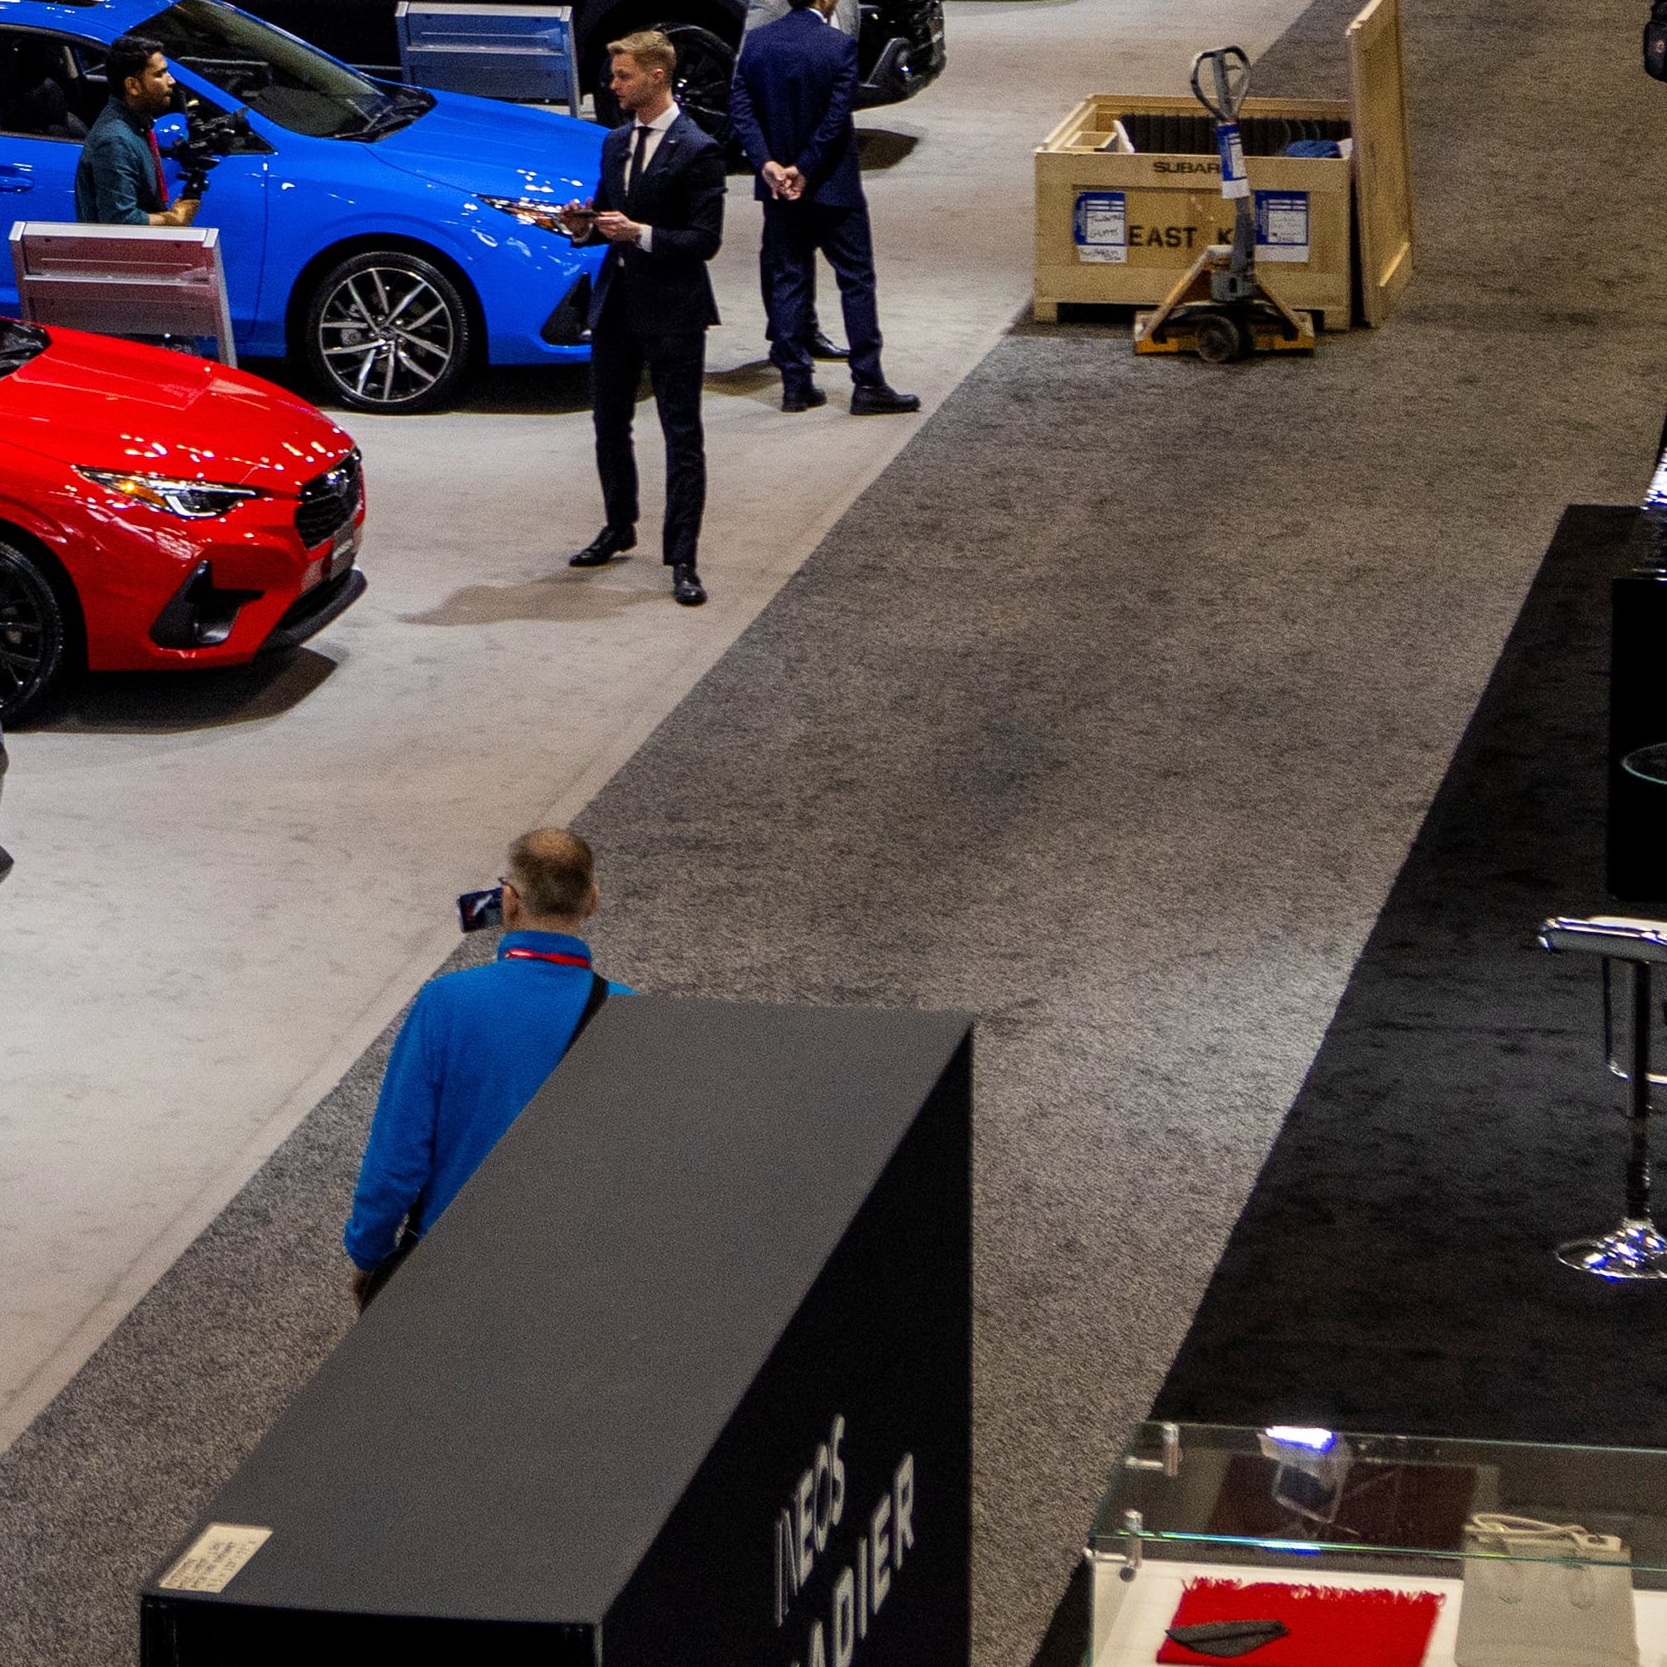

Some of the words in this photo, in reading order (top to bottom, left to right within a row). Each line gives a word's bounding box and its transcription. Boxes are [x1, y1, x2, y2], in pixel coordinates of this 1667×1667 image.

[1153, 161, 1221, 174] SUBAR
[1129, 225, 1197, 248] EAST
[775, 1413, 846, 1628] INEOS
